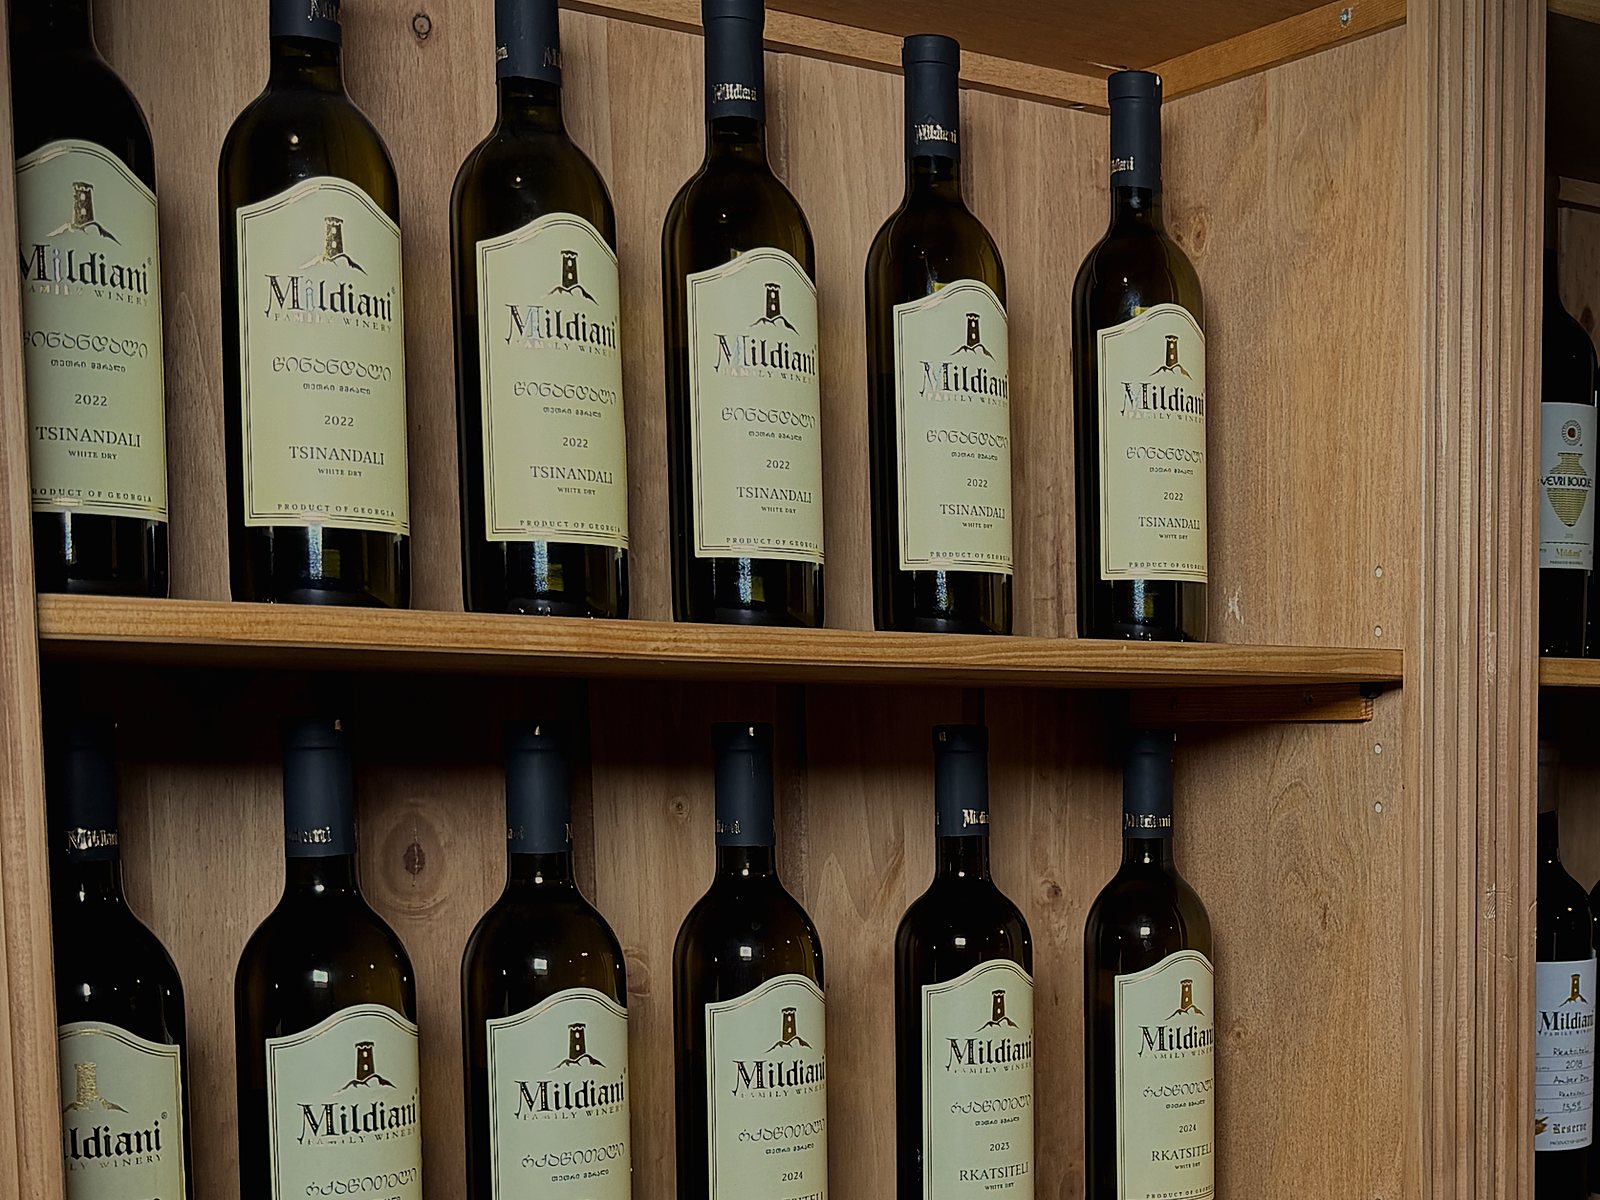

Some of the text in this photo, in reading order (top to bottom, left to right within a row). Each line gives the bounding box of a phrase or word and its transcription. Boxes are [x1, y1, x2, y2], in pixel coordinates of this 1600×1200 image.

[20, 243, 149, 295] Mildiani
[264, 274, 392, 322] Mildiani
[343, 317, 392, 333] WINERY
[505, 304, 616, 349] Mildiani
[714, 333, 816, 376] Mildiani
[919, 361, 1008, 400] Mildiani
[74, 393, 108, 407] 2022
[1120, 382, 1204, 417] Mildiani
[324, 415, 354, 427] 2022
[35, 426, 142, 448] TSINANDALI
[562, 437, 589, 448] 2022
[68, 450, 118, 460] WHITE DRY
[289, 446, 385, 466] TSINANDALI
[318, 467, 344, 476] WHITE
[766, 459, 790, 470] 2022
[530, 465, 613, 484] TSINANDALI
[557, 486, 581, 495] WHITE
[967, 478, 988, 488] 2022
[88, 490, 152, 503] OF GEORGIA
[736, 486, 812, 504] TSINANDALI
[1163, 492, 1184, 501] 2022
[277, 503, 331, 512] PRODUCT
[353, 506, 395, 517] GEORGIA
[940, 504, 1005, 519] TSINANDALI
[520, 520, 569, 528] PRODUCT
[1138, 516, 1200, 530] TSINANDALI
[1538, 1010, 1594, 1035] Mildian
[945, 1035, 1032, 1072] Mildiani
[732, 1056, 825, 1096] Mildiani
[514, 1074, 624, 1119] Mildiani
[297, 1095, 416, 1145] Mildiani
[1179, 1124, 1197, 1133] 2024
[63, 1120, 162, 1160] ldiani
[1152, 1142, 1212, 1161] RKATSITELI
[100, 1154, 161, 1168] WINERY
[782, 1171, 803, 1182] 2024
[959, 1161, 1029, 1181] RKATSITELI
[1146, 1191, 1183, 1199] PRODUCT
